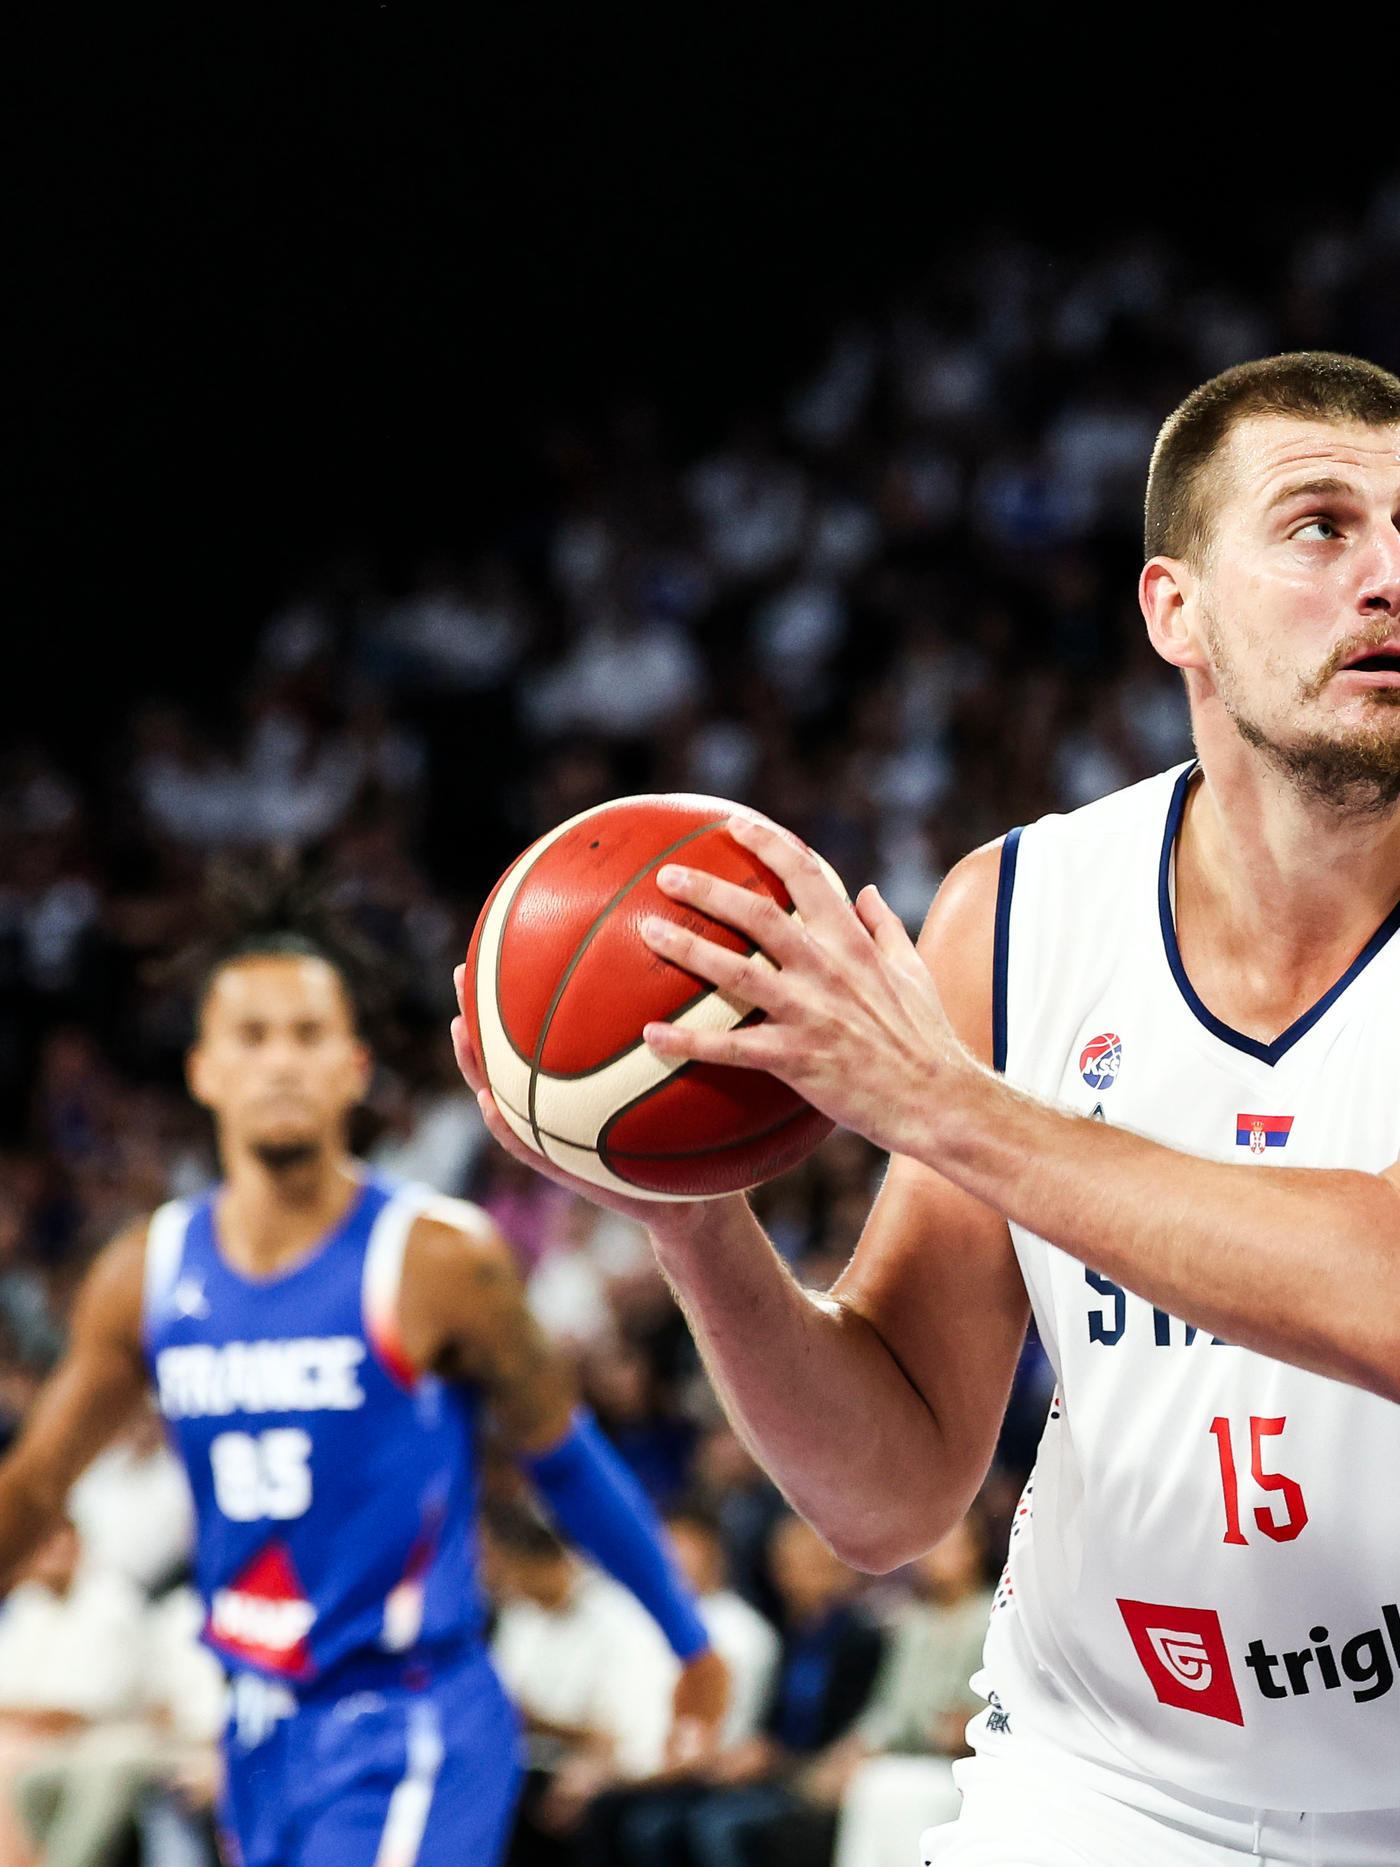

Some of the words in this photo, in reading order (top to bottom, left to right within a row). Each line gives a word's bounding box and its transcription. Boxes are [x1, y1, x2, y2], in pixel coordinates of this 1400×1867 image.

[1081, 1053, 1121, 1078] KSS
[157, 1336, 366, 1420] FRANCE
[1209, 1416, 1309, 1545] 15
